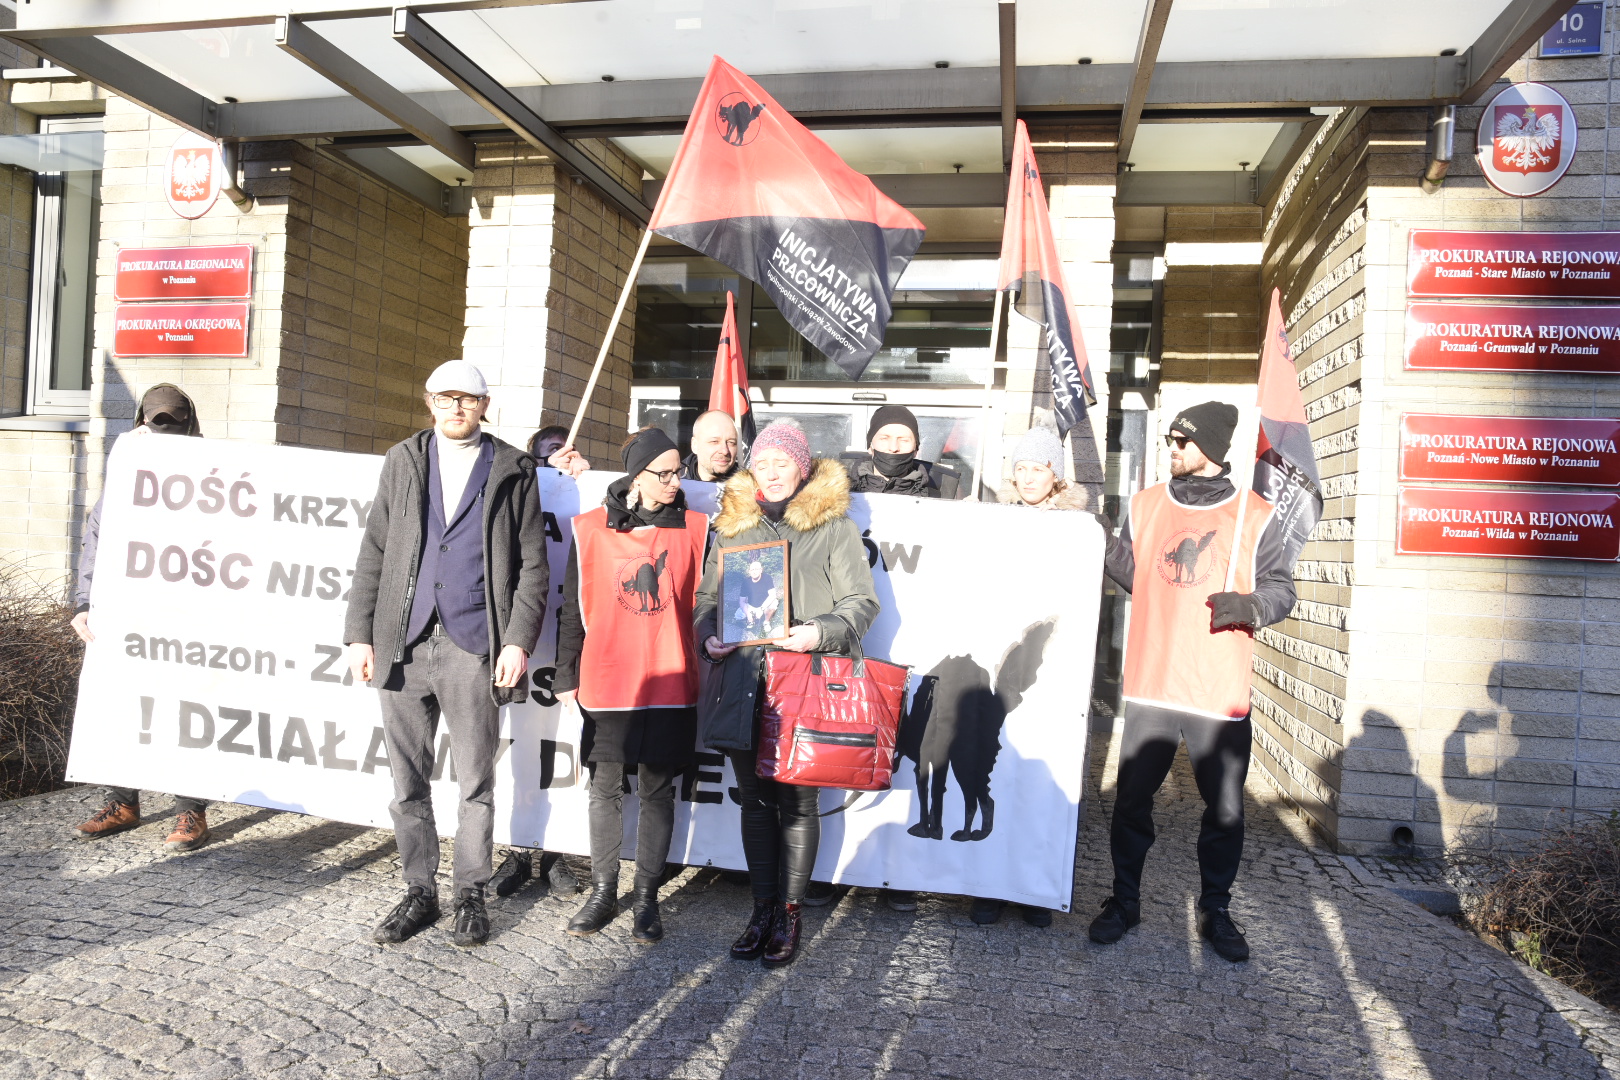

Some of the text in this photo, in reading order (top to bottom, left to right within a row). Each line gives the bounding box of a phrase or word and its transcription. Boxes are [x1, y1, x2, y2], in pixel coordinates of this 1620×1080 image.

[1560, 13, 1584, 32] 10
[1420, 249, 1536, 264] PROKURATURA
[120, 258, 244, 272] PROKURATURA REGIONALNA
[168, 276, 196, 284] Poznaniu
[778, 228, 877, 322] INICJATYWA
[1510, 267, 1546, 279] Miasto
[1550, 270, 1559, 279] w
[1561, 268, 1610, 280] Poznaniu
[772, 247, 869, 339] PRACOWNICZA
[117, 318, 242, 332] PROKURATURA OKRĘGOWA
[798, 300, 825, 325] Związek
[823, 321, 857, 355] Zawodowy
[165, 332, 194, 342] Poznaniu
[1538, 344, 1548, 354] w
[1550, 343, 1599, 355] Poznaniu
[1410, 434, 1617, 454] PROKURATURA REJONOWA
[1502, 454, 1536, 466] Miasto
[1540, 457, 1548, 466] w
[1551, 456, 1600, 468] Poznaniu
[133, 468, 258, 518] DOŚĆ
[1408, 508, 1614, 528] PROKURATURA REJONOWA
[1518, 532, 1528, 540] w
[1530, 530, 1578, 542] Poznaniu
[124, 633, 276, 676] amazon
